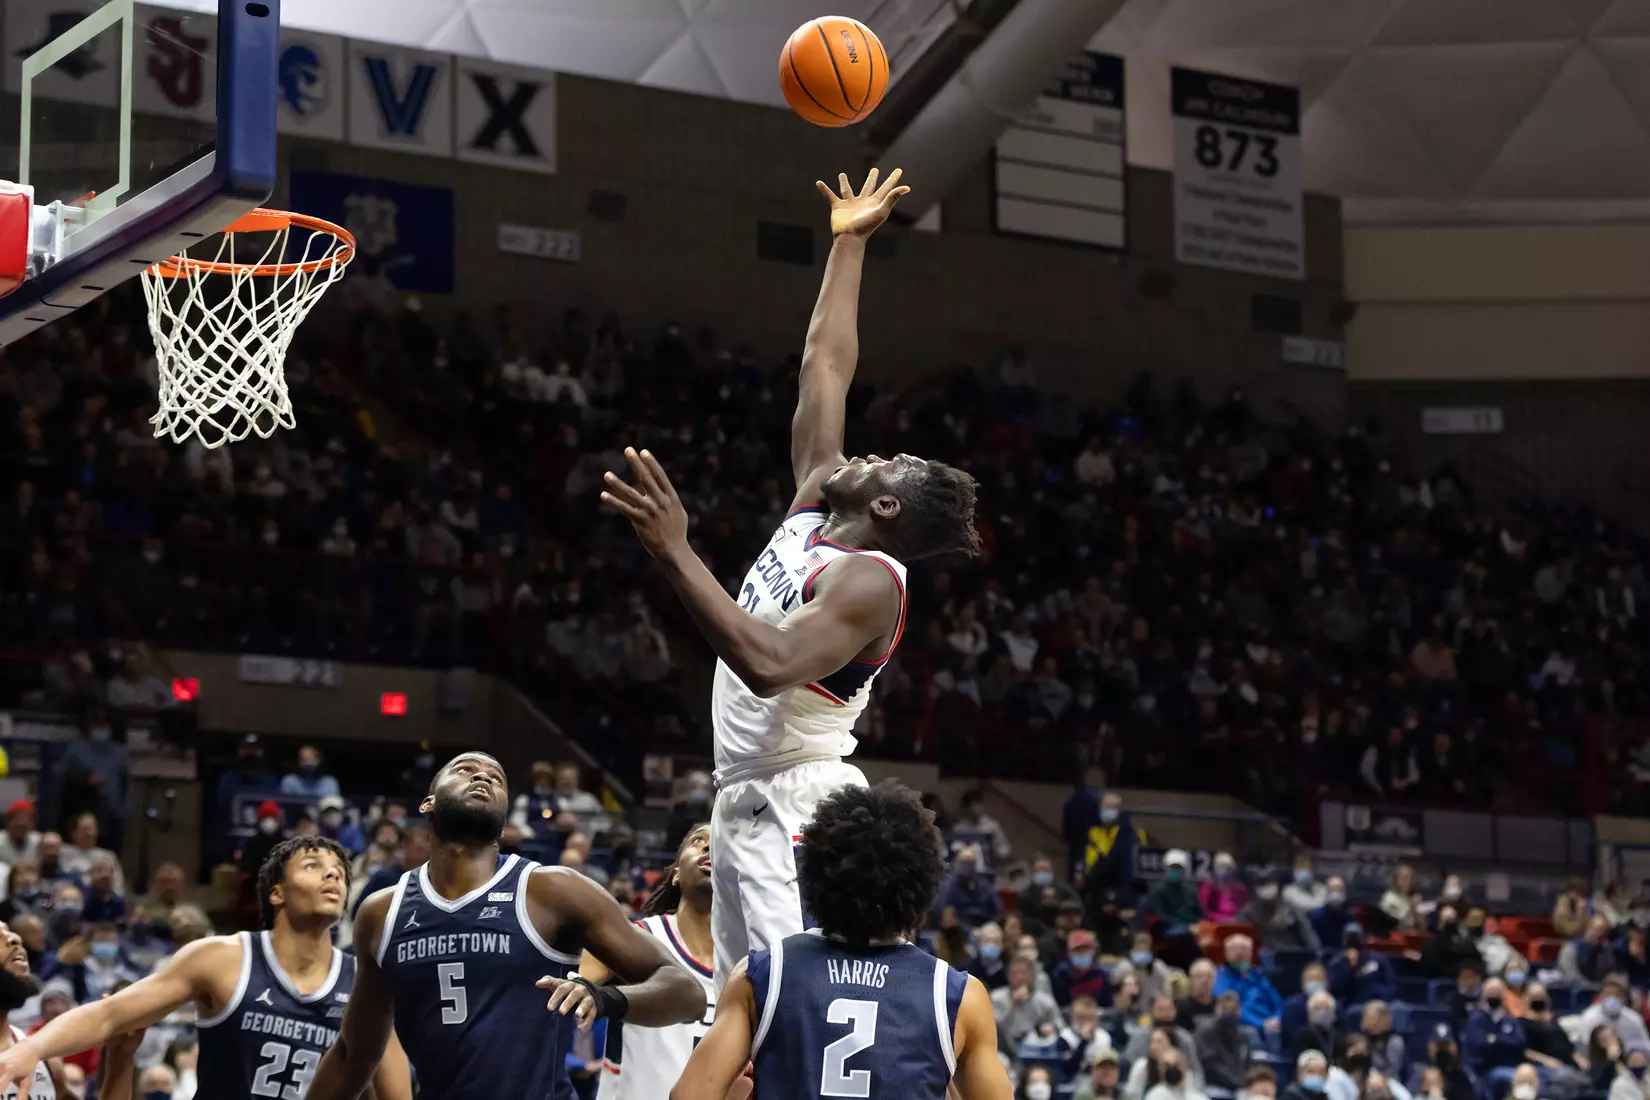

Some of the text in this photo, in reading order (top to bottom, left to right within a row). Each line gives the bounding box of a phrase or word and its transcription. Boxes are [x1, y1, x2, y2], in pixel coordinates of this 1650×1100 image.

[839, 29, 859, 64] UCONN
[362, 55, 439, 137] V
[468, 71, 544, 159] X
[1195, 125, 1279, 178] 873
[756, 546, 799, 612] CONN
[397, 933, 511, 963] GEORGETOWN
[827, 959, 889, 988] HARRIS
[437, 962, 468, 1024] 5
[240, 1011, 340, 1047] GEORGETOW
[820, 998, 878, 1097] 2
[250, 1041, 322, 1100] 23
